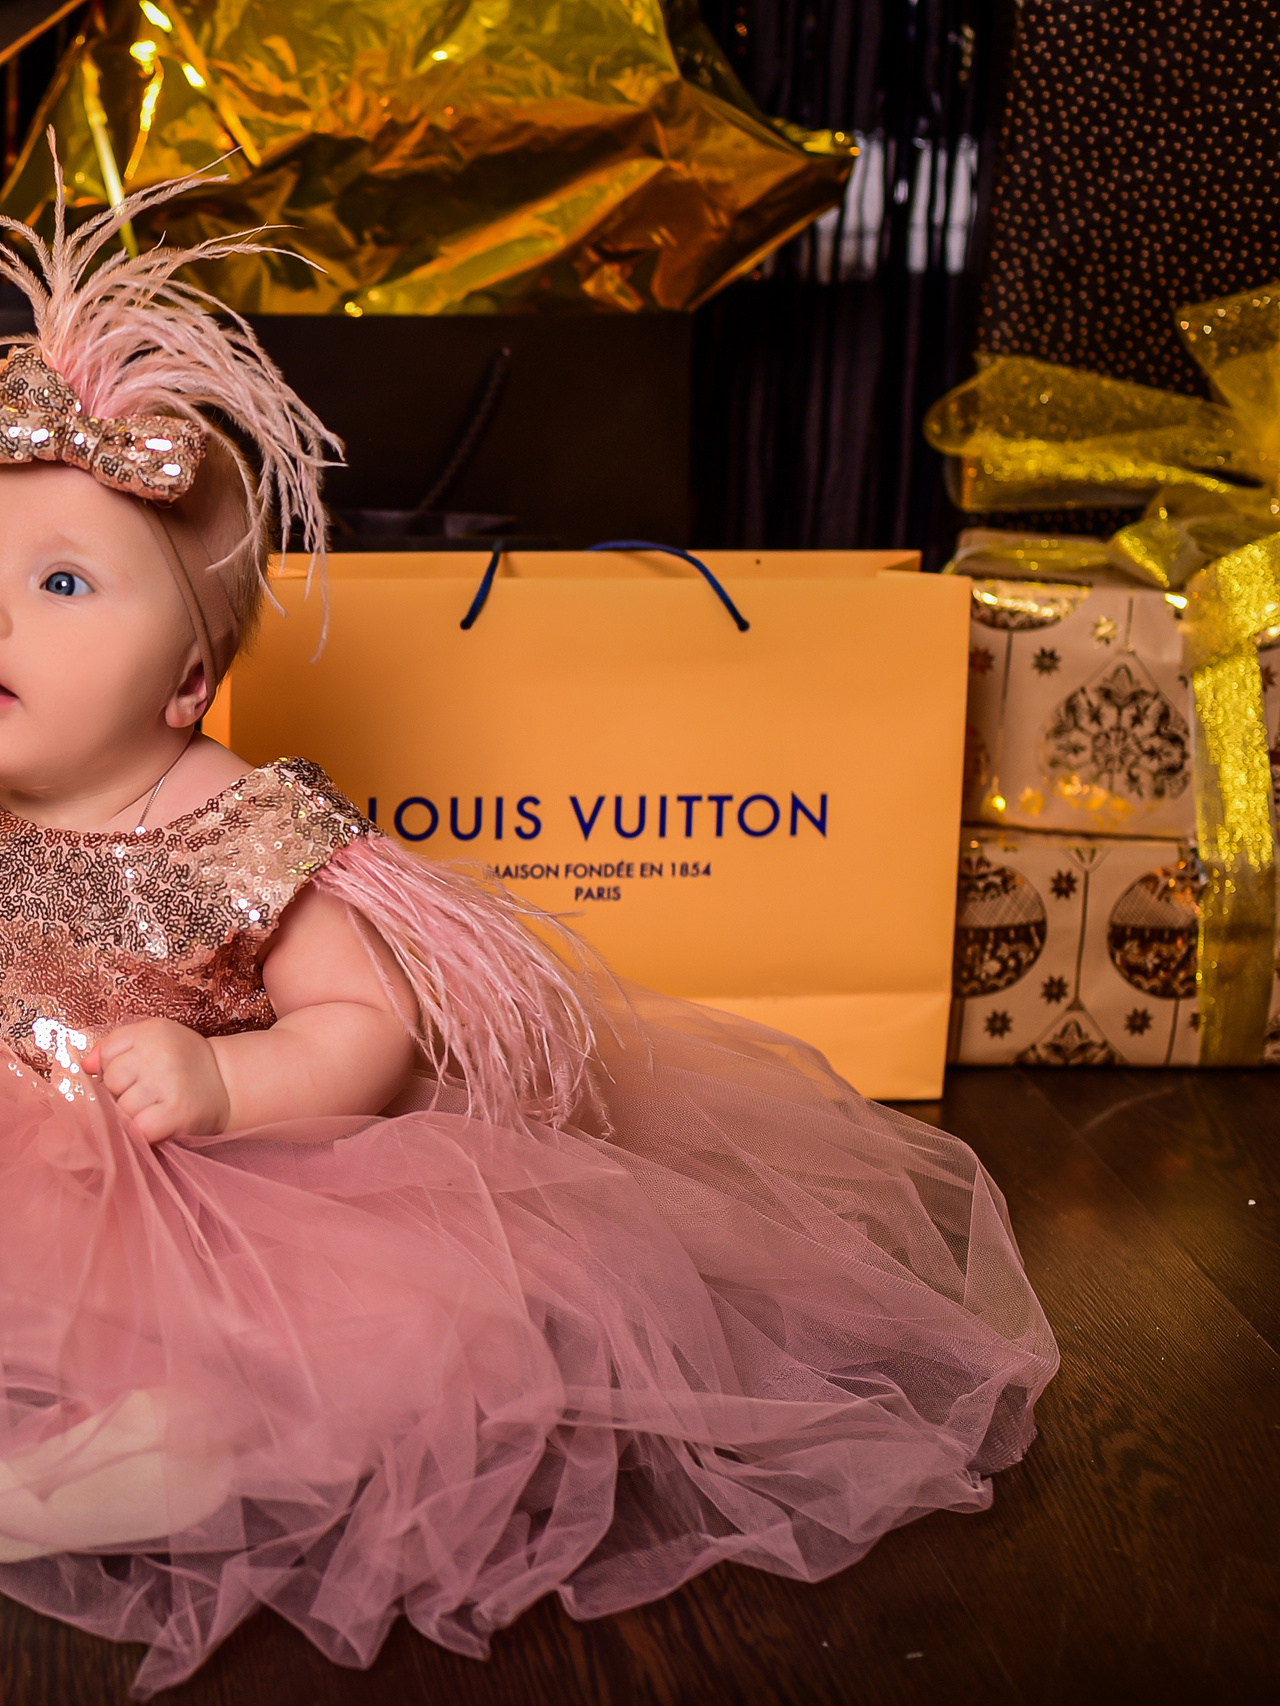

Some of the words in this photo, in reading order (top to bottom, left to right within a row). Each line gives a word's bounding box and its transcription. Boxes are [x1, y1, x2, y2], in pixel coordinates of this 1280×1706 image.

[568, 790, 828, 842] VUITTON
[564, 860, 635, 879] FONDÉE
[639, 862, 664, 878] EN
[670, 861, 712, 878] 1854
[574, 885, 622, 902] PARIS
